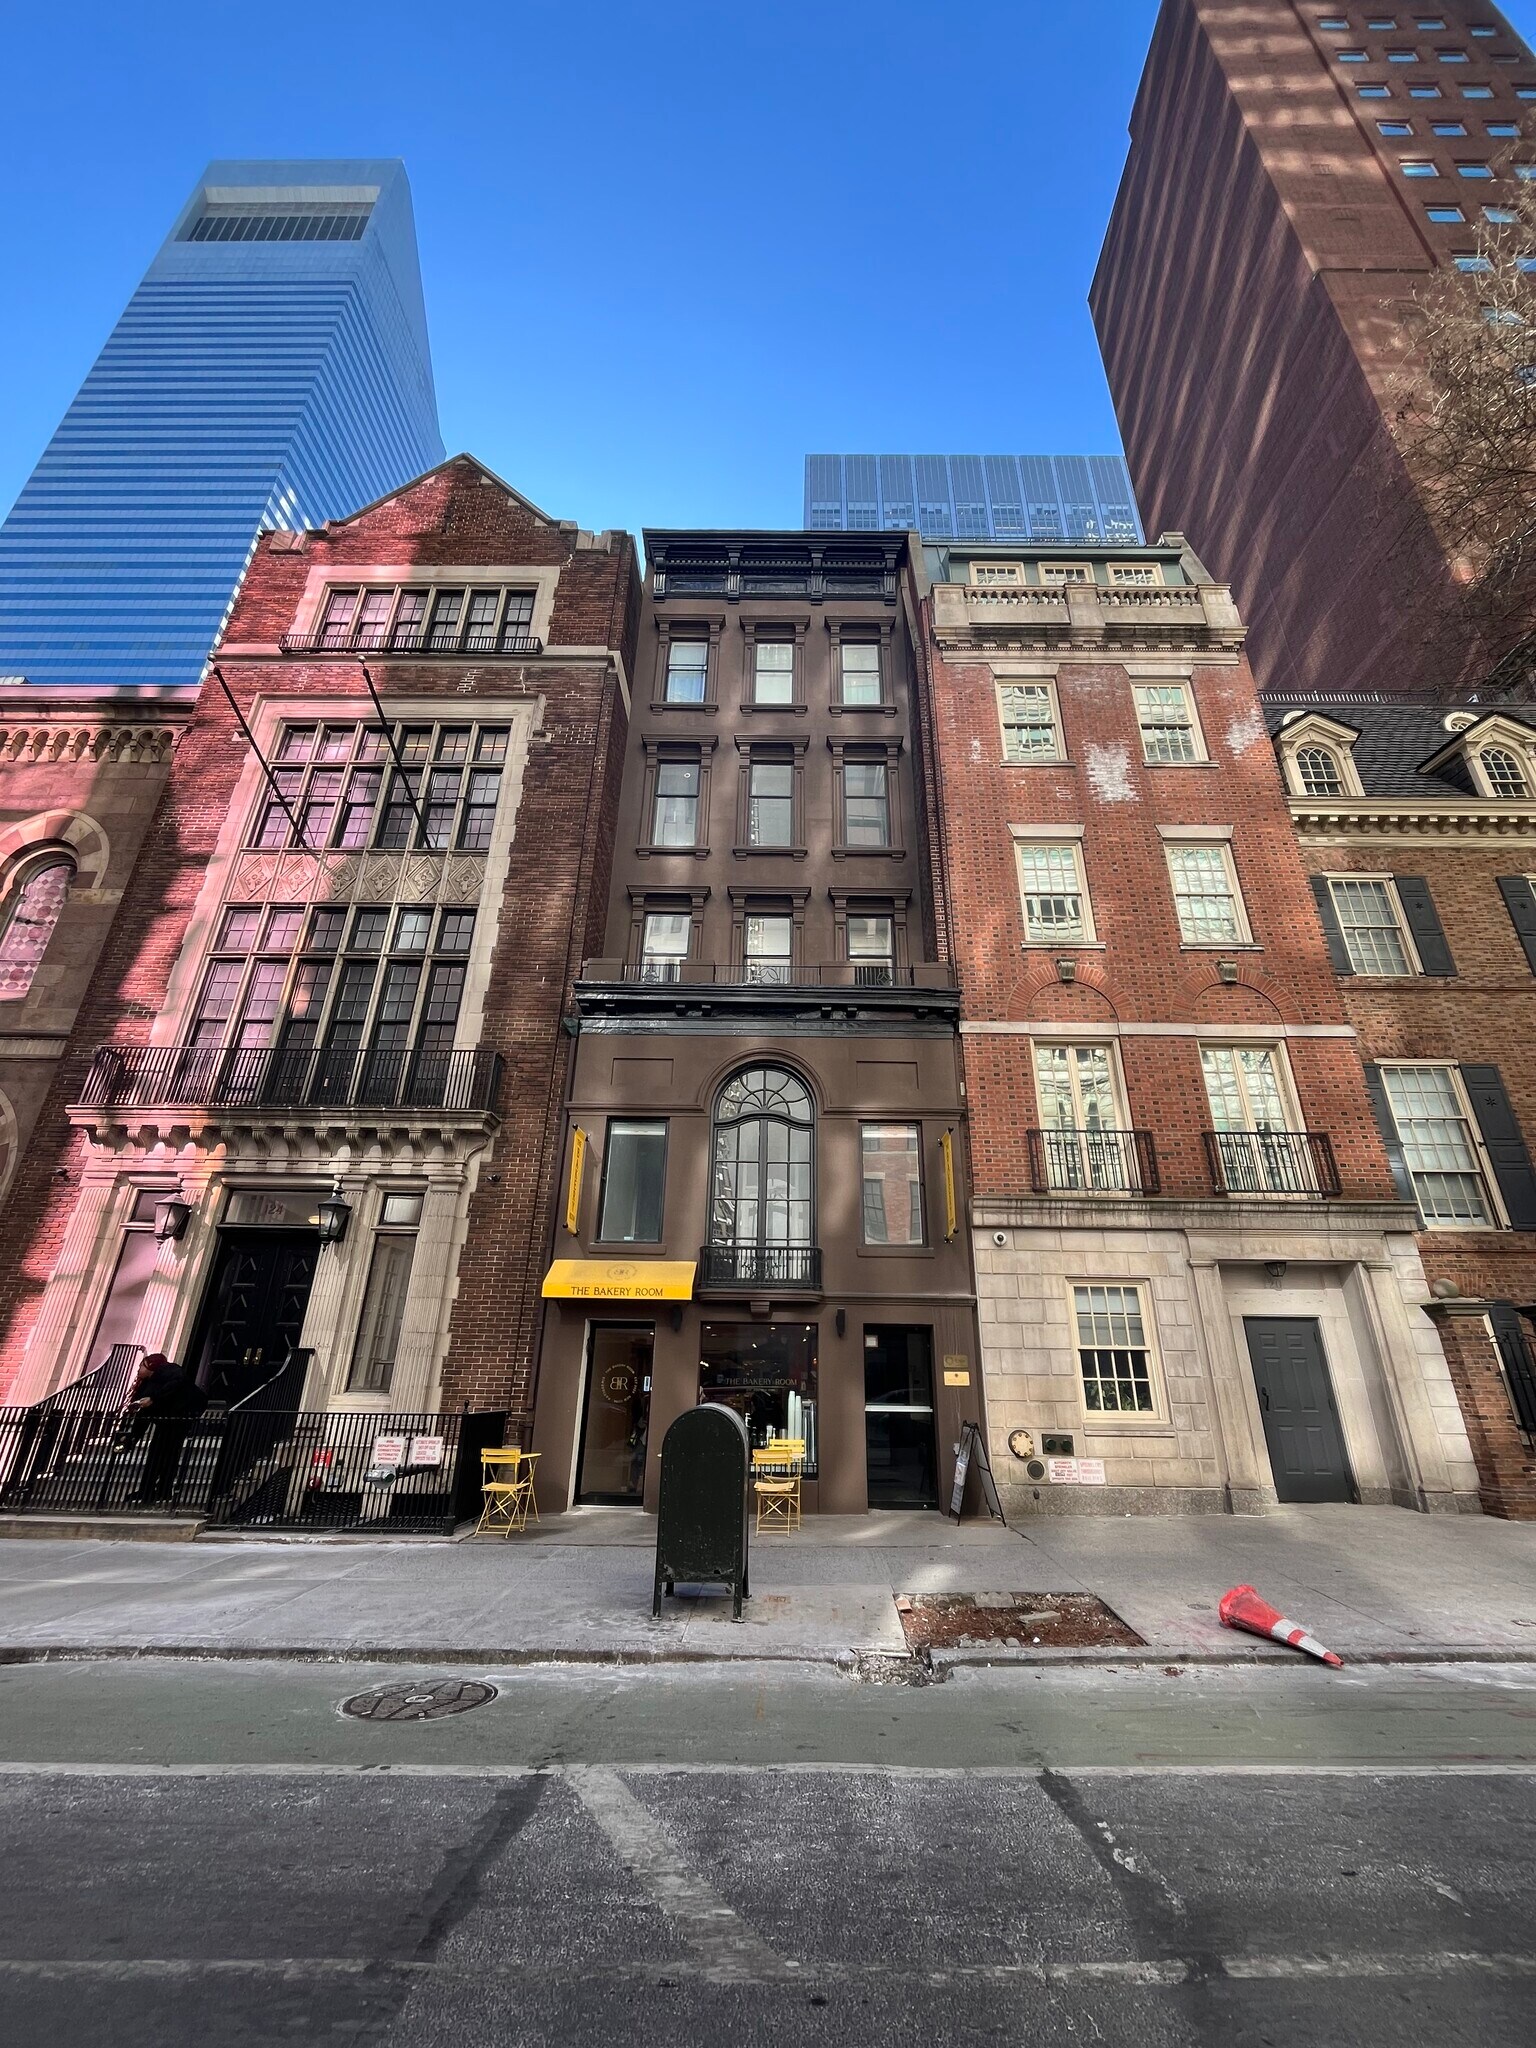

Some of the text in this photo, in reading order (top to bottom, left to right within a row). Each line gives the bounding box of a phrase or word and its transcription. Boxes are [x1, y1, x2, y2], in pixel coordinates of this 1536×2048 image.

[571, 1286, 664, 1297] THE BAKERY ROOM
[726, 1377, 798, 1386] THE BAKERY ROOM
